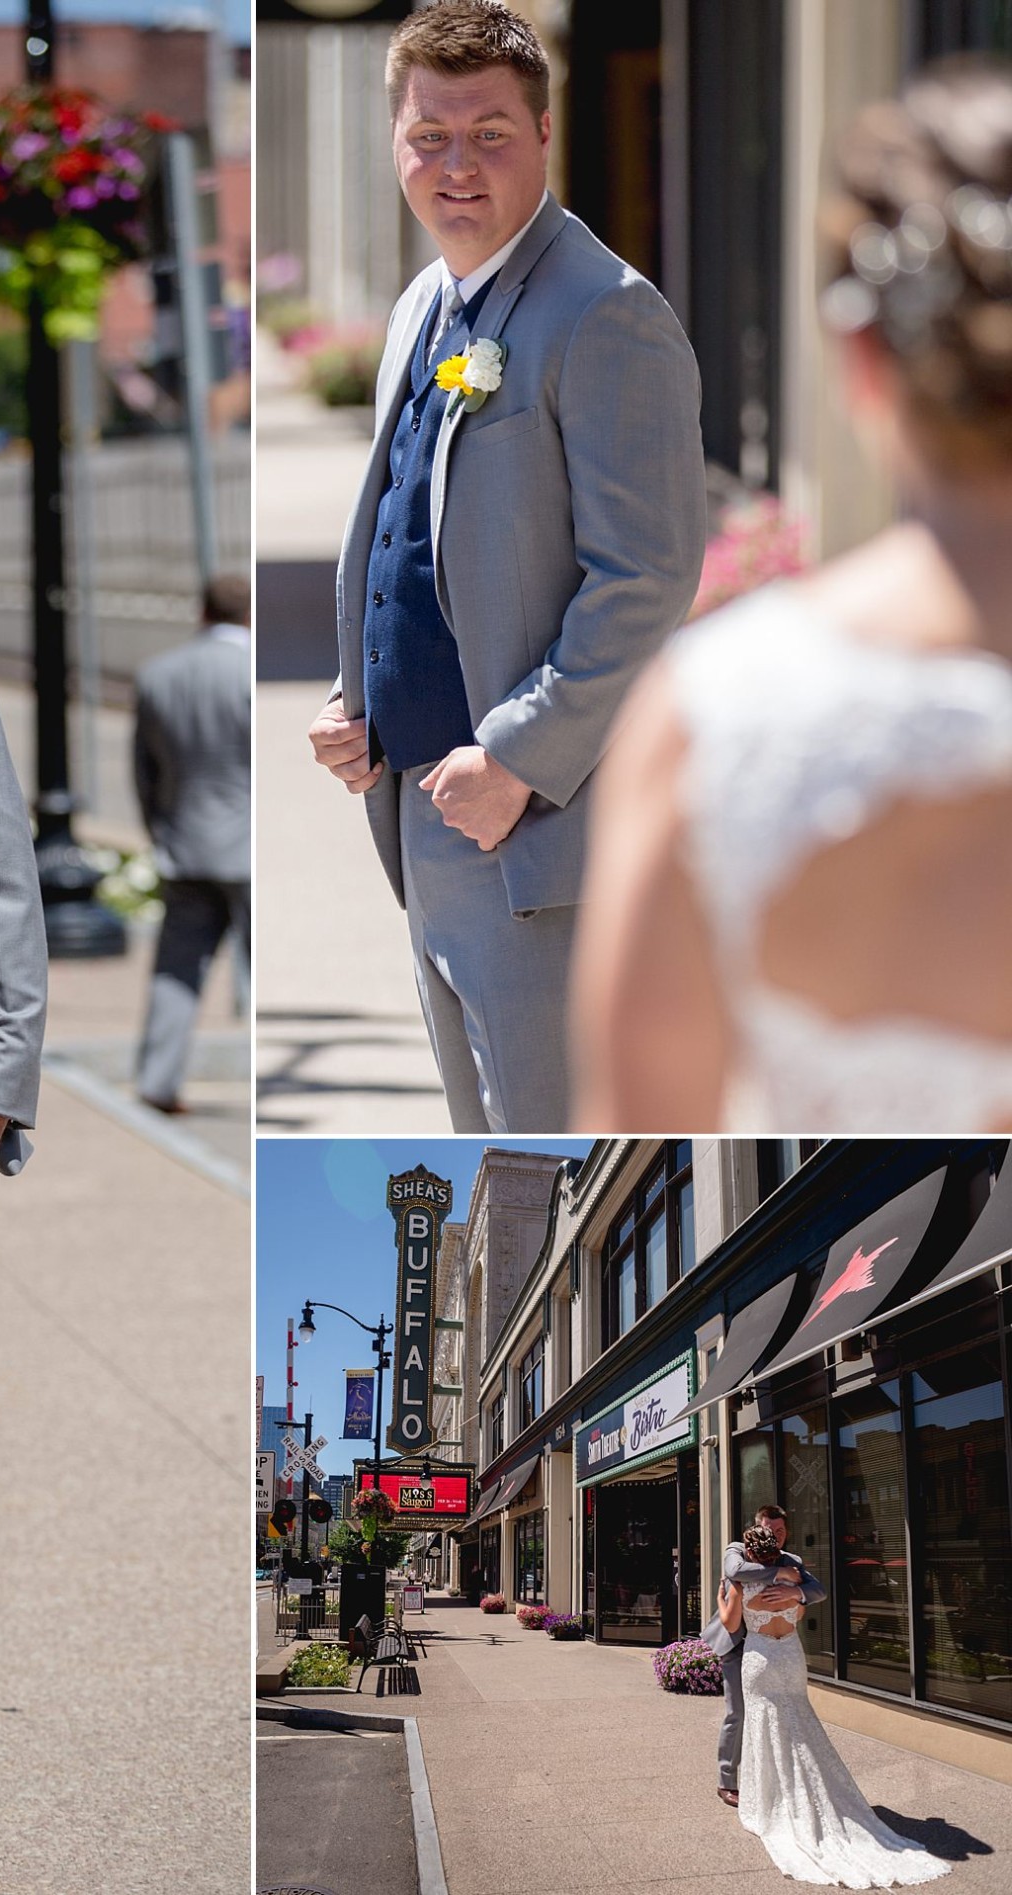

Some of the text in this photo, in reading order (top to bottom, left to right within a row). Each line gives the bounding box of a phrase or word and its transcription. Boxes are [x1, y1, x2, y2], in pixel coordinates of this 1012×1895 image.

[392, 1181, 448, 1203] SHEA'S
[401, 1213, 429, 1441] BUFFALO
[630, 1398, 667, 1451] Bistro
[282, 1438, 326, 1478] CROSSING
[282, 1436, 325, 1482] RAIL ROAD
[401, 1496, 433, 1509] Saigon
